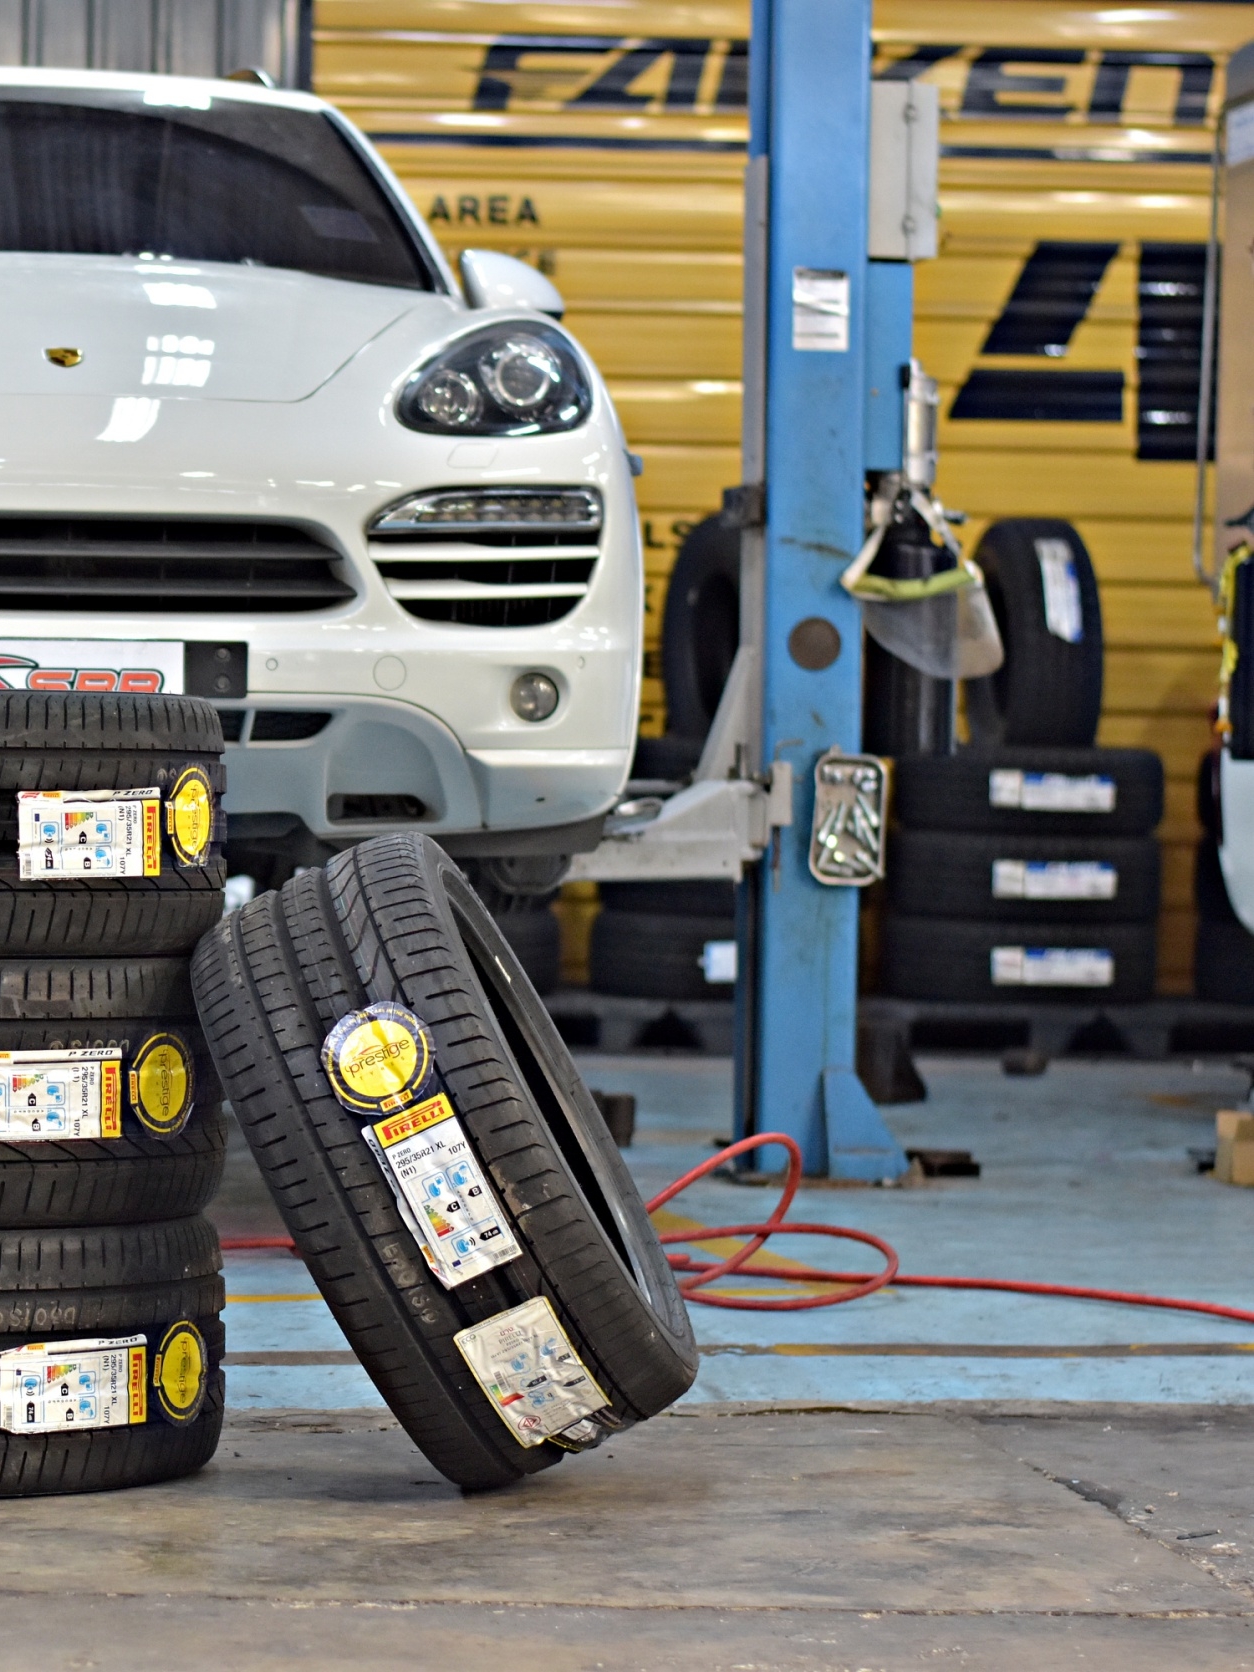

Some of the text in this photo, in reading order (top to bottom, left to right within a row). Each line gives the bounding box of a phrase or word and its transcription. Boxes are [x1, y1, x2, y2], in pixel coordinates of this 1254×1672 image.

[429, 194, 540, 226] AREA
[125, 848, 132, 856] XL
[146, 806, 157, 869] PIRELLI
[348, 1039, 410, 1078] prestige
[81, 1066, 89, 1119] 295/35R21 XL
[104, 1067, 117, 1131] PIRELLI
[156, 1050, 173, 1116] prestige
[381, 1100, 445, 1141] PIRELLI
[395, 1140, 447, 1169] 295/35R21 XL
[397, 1147, 412, 1158] ZERO
[400, 1141, 467, 1180] (N1) 107Y
[102, 1355, 110, 1371] (N1)
[110, 1396, 117, 1406] XL
[132, 1353, 143, 1416] PIRELLI
